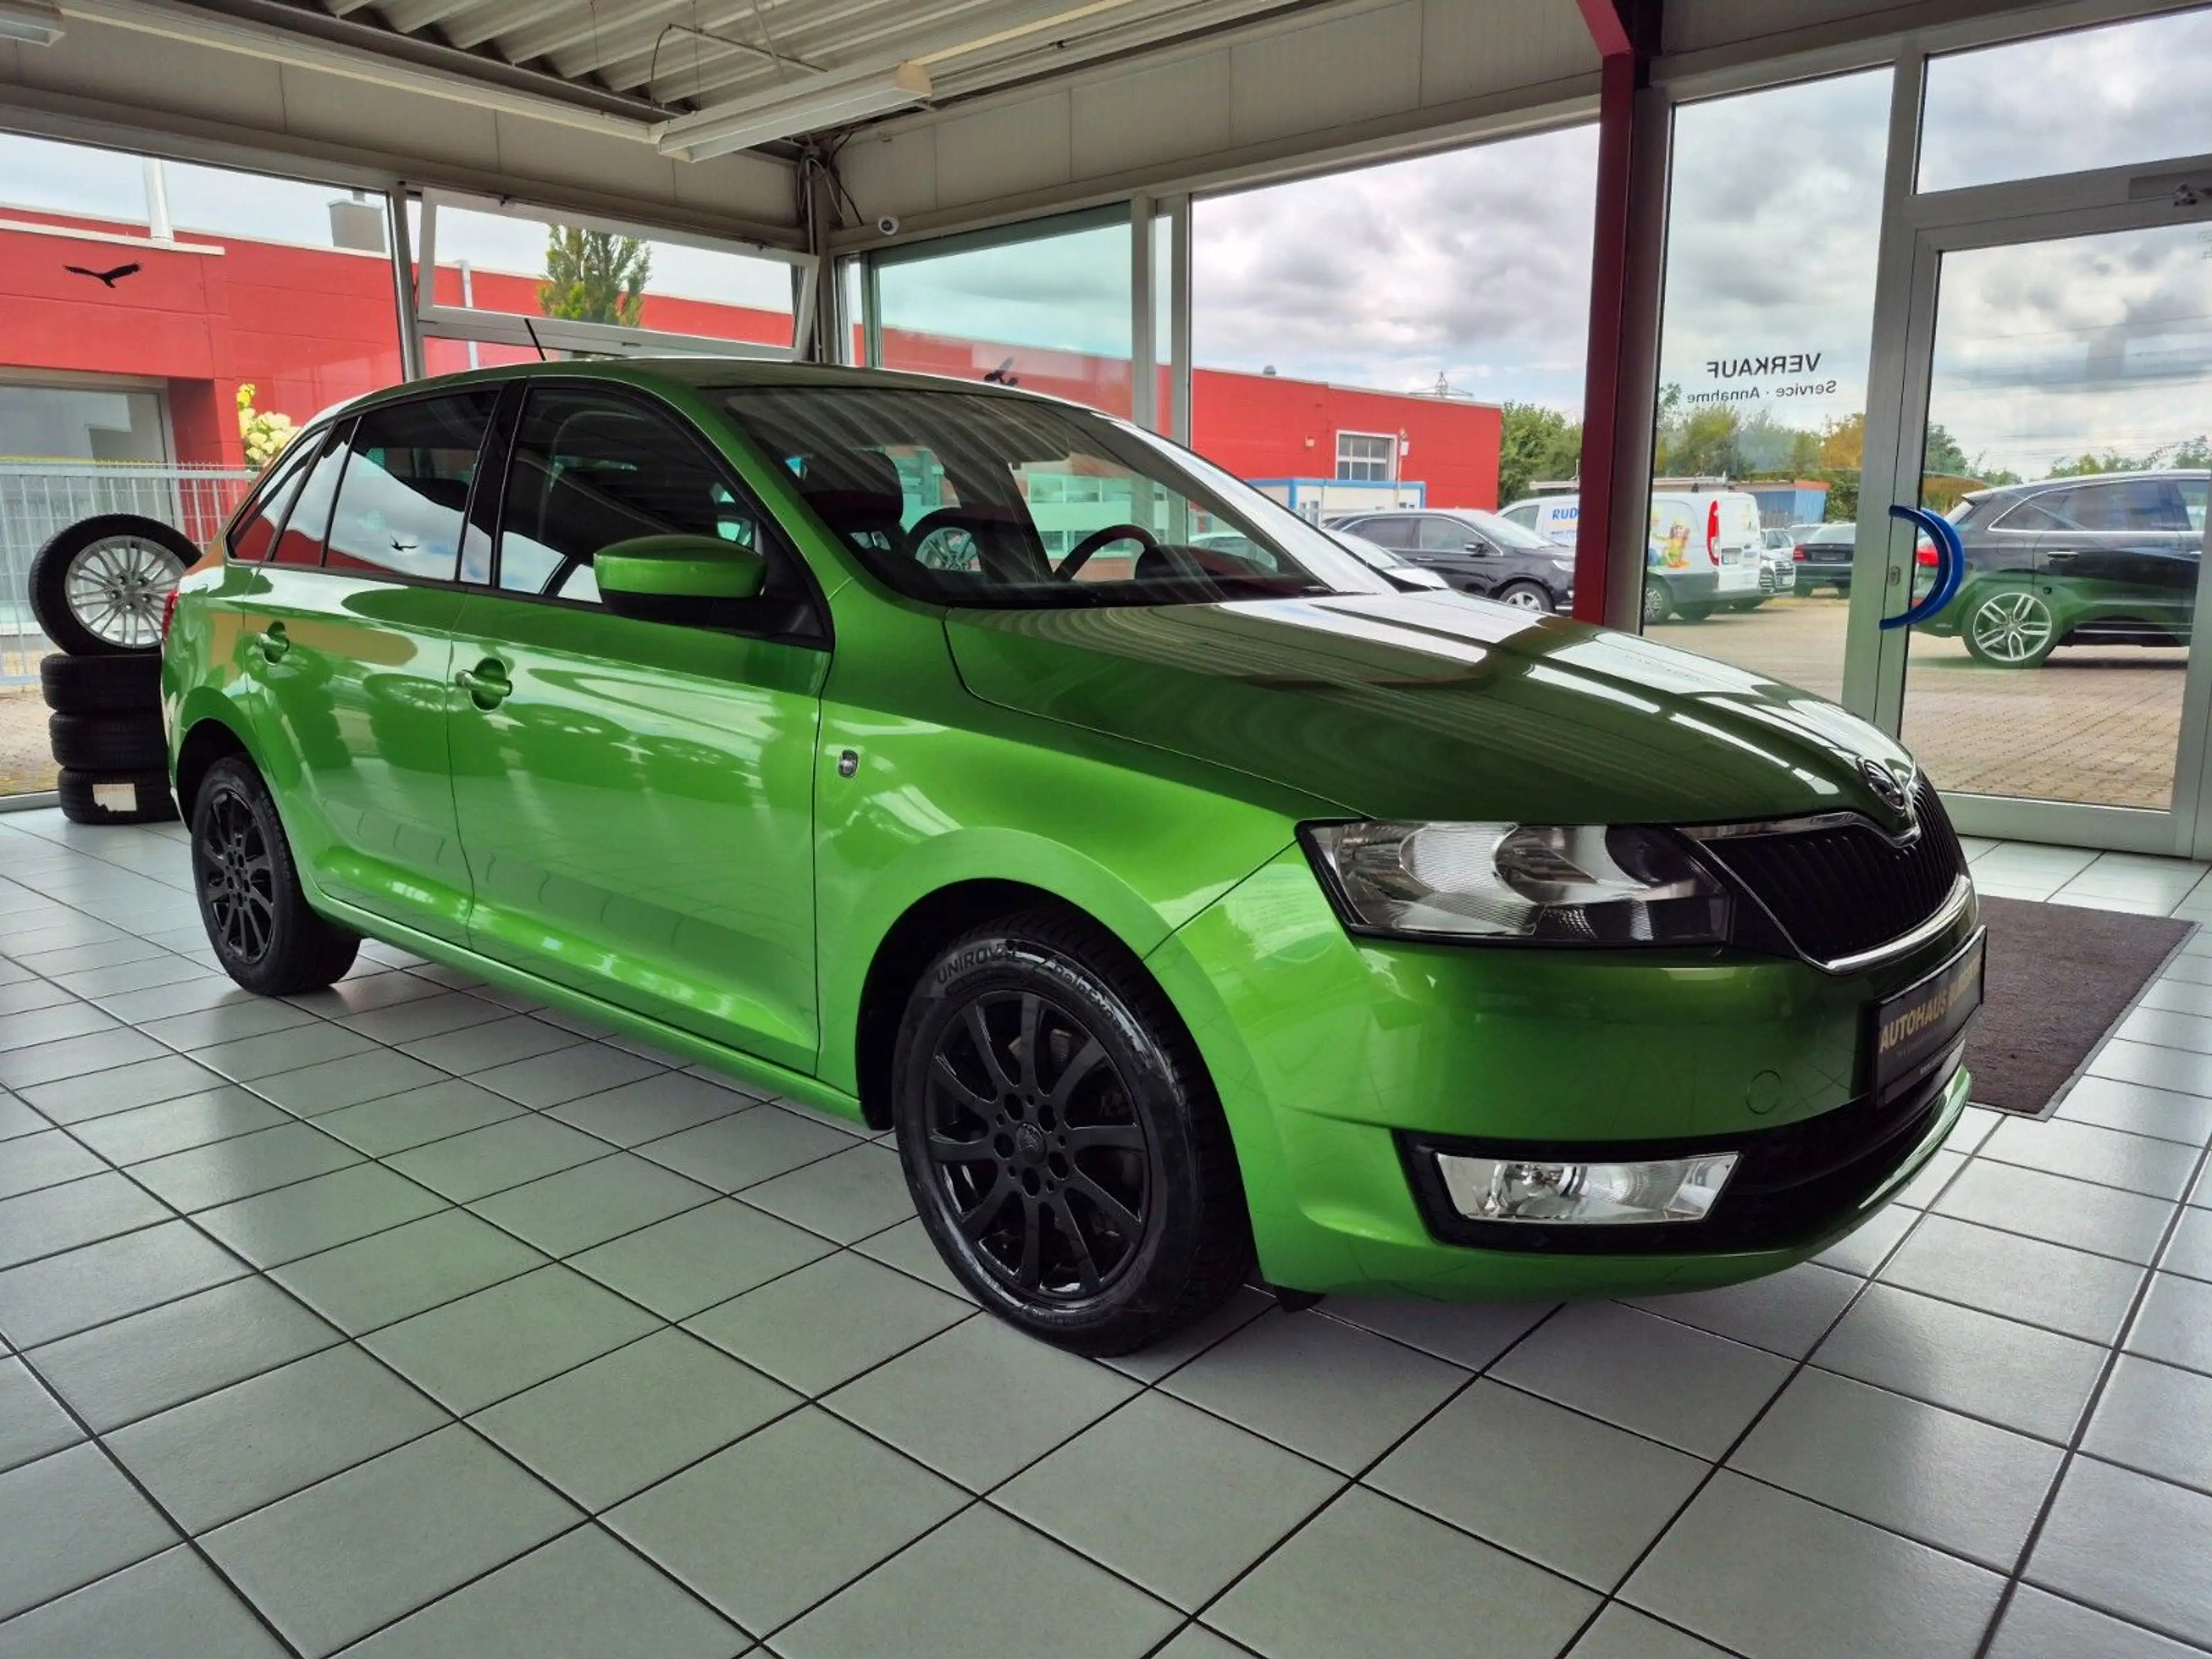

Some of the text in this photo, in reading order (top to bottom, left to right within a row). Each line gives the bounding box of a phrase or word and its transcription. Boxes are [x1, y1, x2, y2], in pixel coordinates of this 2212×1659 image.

[1552, 507, 1578, 520] RUD
[936, 942, 1022, 984] UNIROYAL
[1879, 989, 1948, 1054] AUTOHAUS
